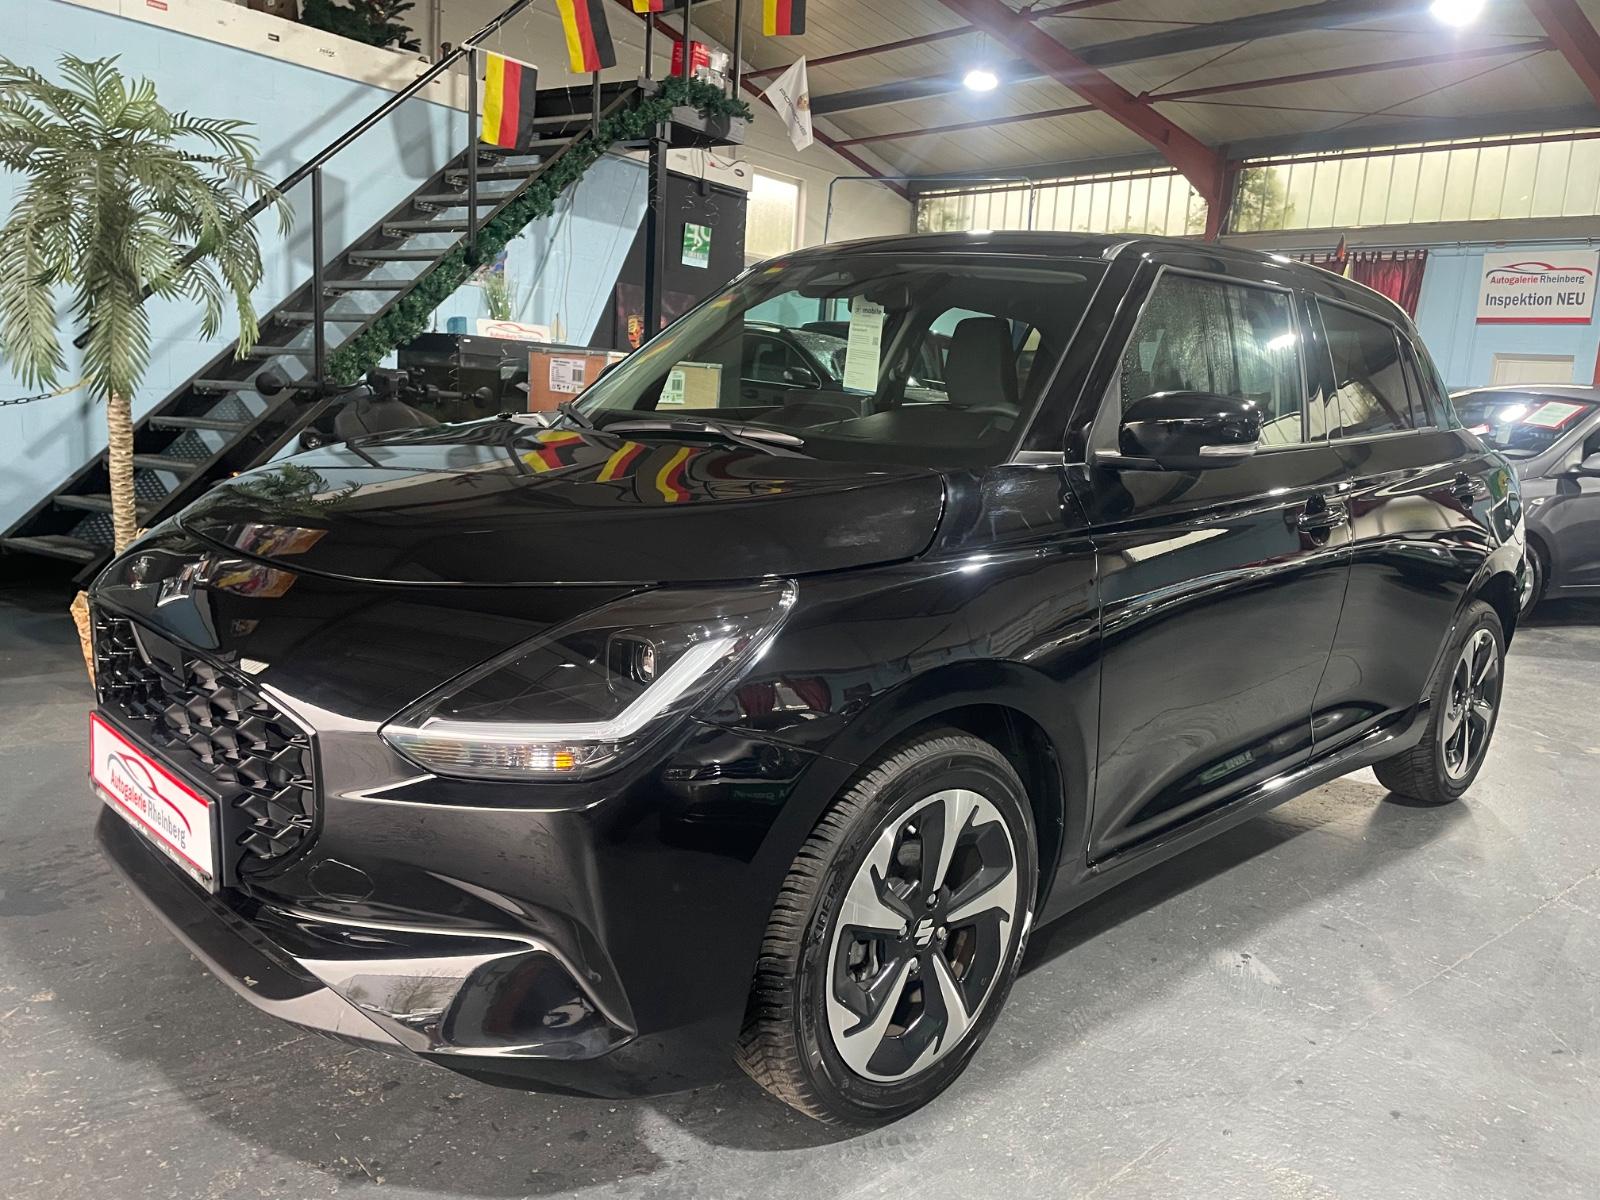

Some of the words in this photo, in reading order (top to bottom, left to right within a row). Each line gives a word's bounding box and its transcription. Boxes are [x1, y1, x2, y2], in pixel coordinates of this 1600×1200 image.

[1490, 275, 1538, 286] Autogalerie
[1540, 274, 1585, 285] Rheinberg
[1485, 292, 1552, 309] Inspektion
[1556, 291, 1586, 306] NEU
[110, 768, 147, 814] Autogalerie
[147, 799, 187, 850] Rheinberg
